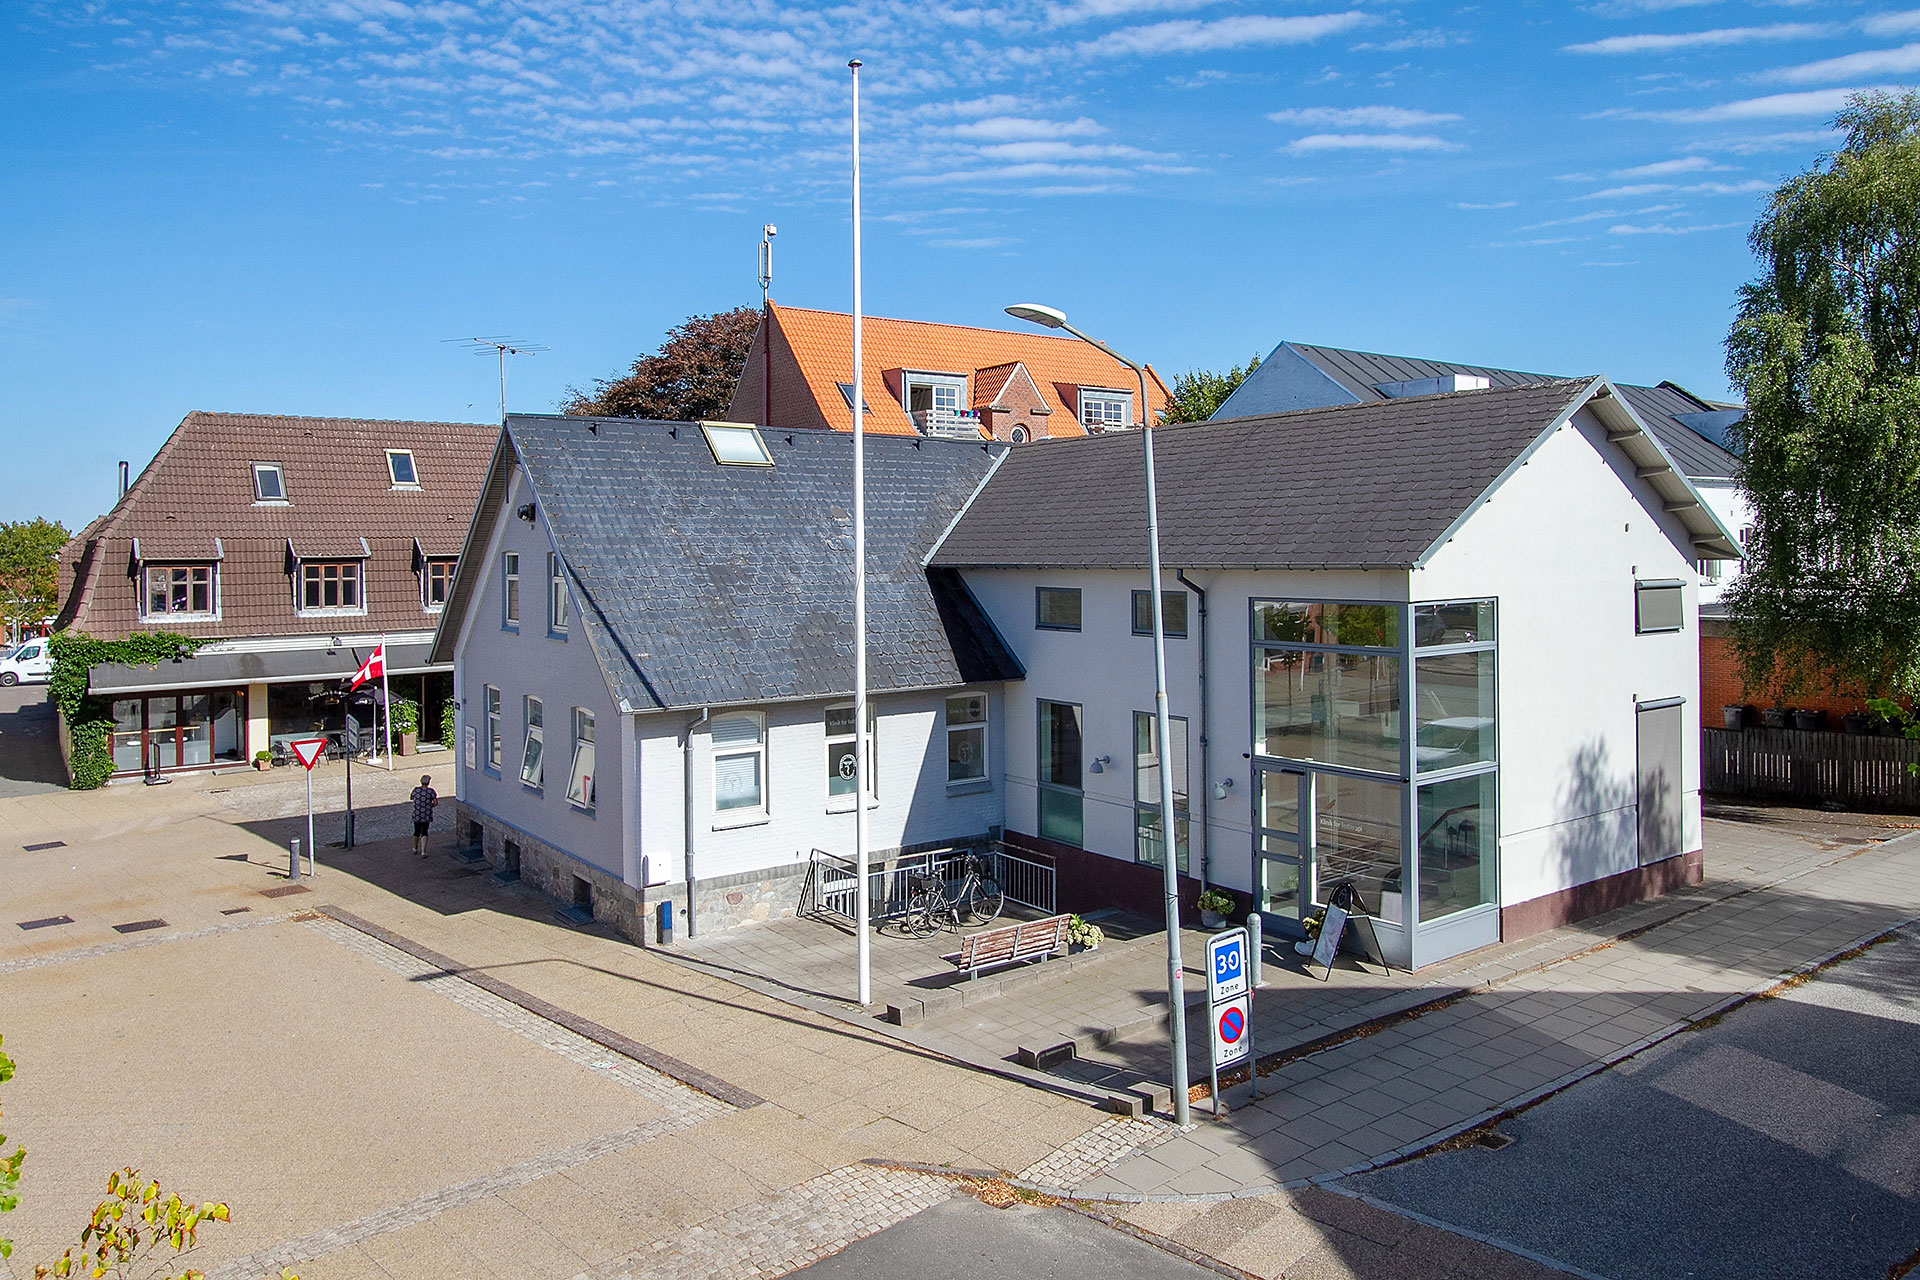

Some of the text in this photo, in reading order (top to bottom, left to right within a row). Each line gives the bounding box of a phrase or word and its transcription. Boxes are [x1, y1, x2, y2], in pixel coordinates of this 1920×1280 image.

[1320, 818, 1332, 826] Klinik
[1217, 950, 1239, 975] 30
[1220, 982, 1239, 995] Zone
[1223, 1045, 1243, 1058] Zone
